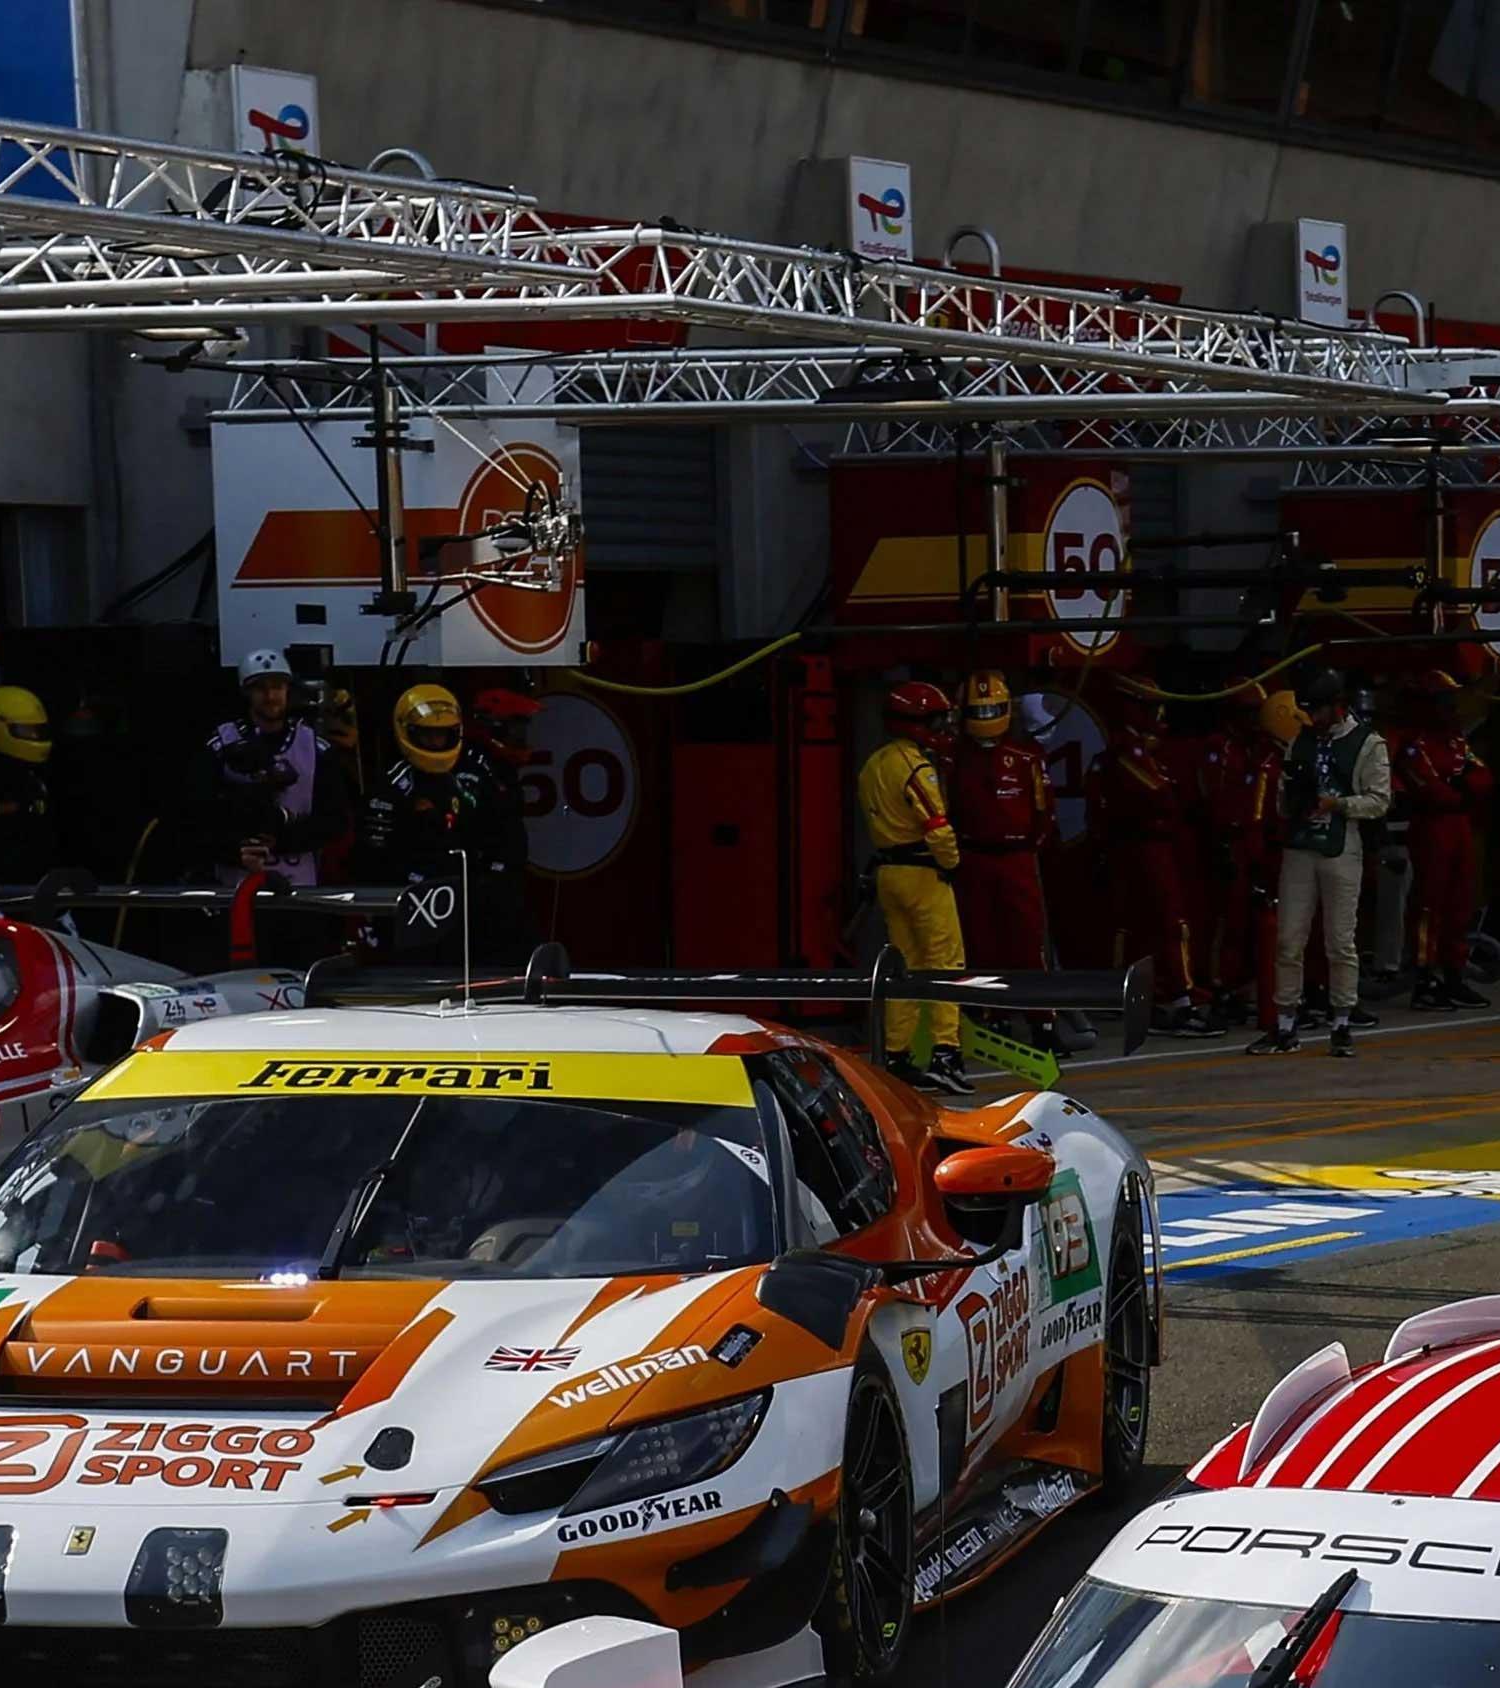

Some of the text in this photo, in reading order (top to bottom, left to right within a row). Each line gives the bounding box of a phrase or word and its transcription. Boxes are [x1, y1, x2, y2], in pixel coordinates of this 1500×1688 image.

[1053, 532, 1120, 595] 50
[406, 885, 455, 929] XO
[236, 1058, 554, 1094] Ferrari
[1040, 1300, 1102, 1350] GOODYEAR
[26, 1345, 360, 1379] VANGUART
[95, 1421, 316, 1458] ZIGGO
[78, 1455, 302, 1492] SPORT
[558, 1490, 723, 1544] GOODYEAR
